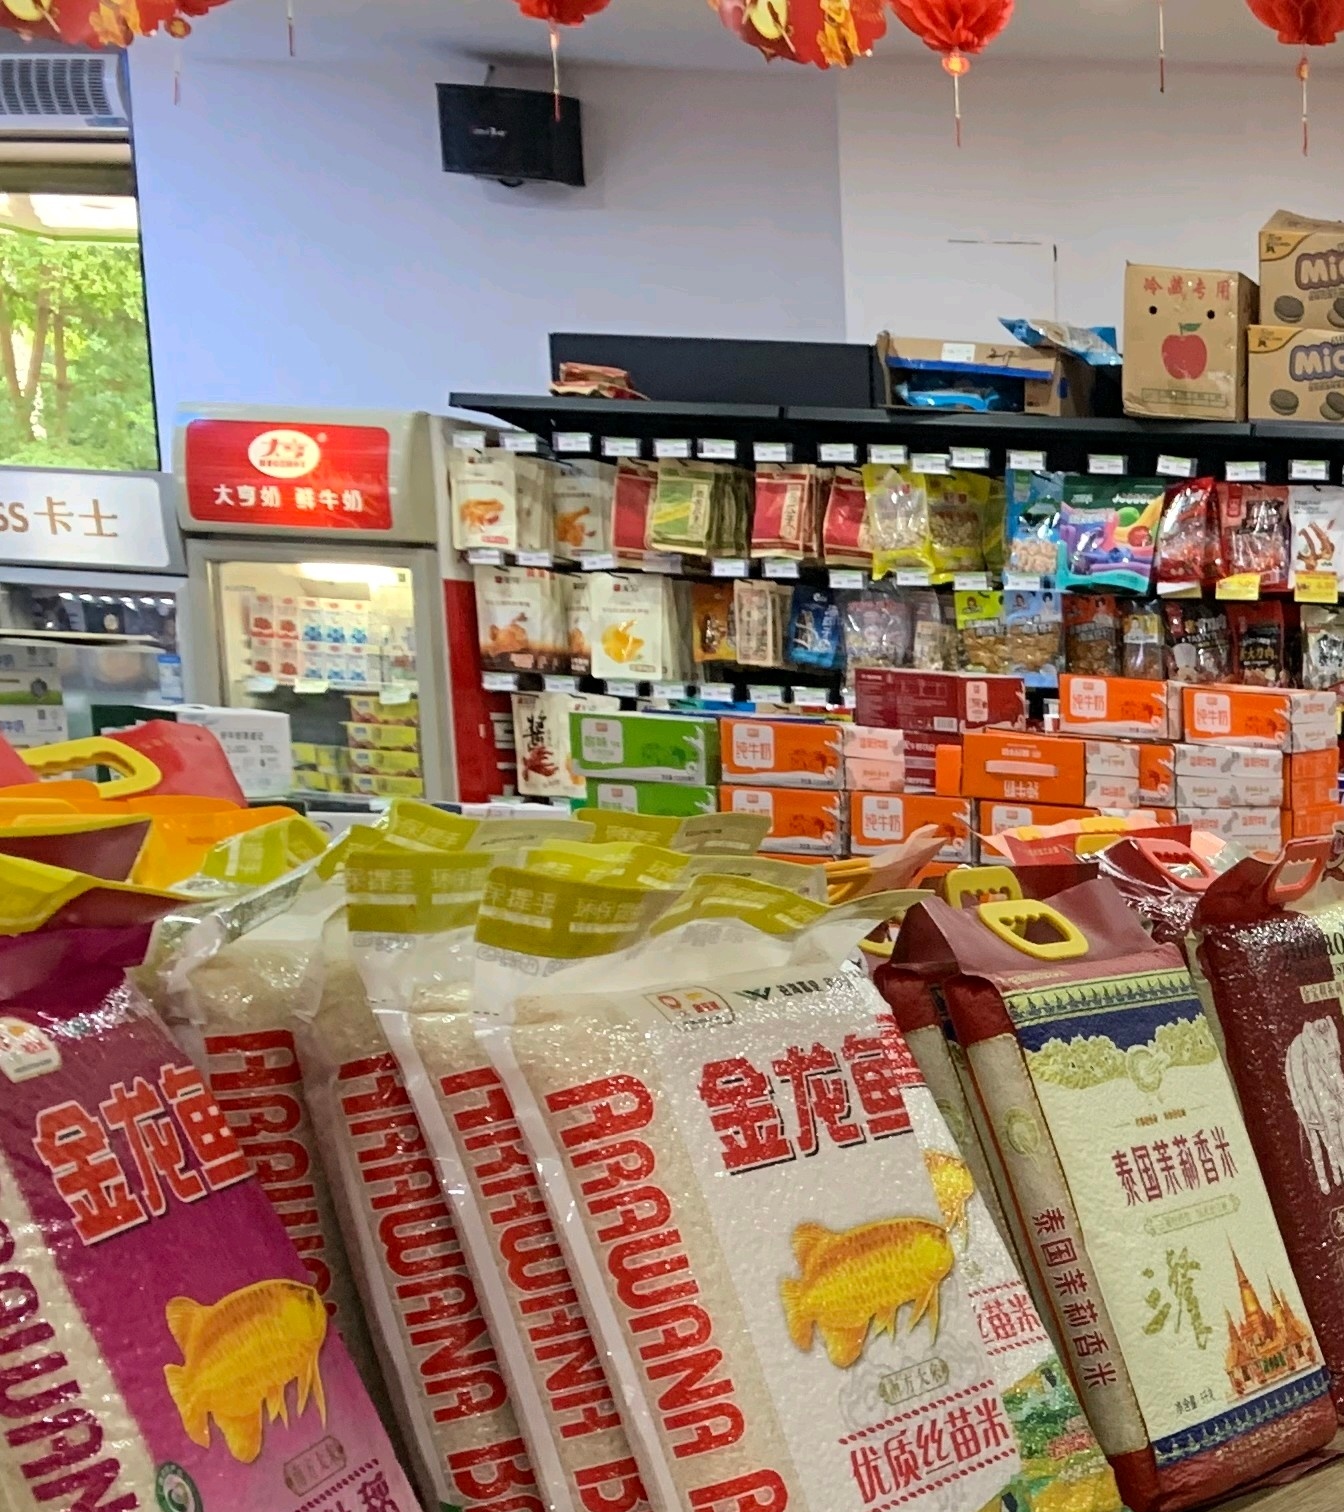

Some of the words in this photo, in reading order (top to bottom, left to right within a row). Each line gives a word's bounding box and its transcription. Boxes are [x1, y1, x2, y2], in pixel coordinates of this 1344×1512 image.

[33, 496, 118, 537] 卡士
[213, 484, 280, 508] 大亨奶
[294, 486, 364, 513] 鲜牛奶
[736, 742, 771, 760] 纯牛奶
[34, 1063, 257, 1246] 金龙鱼
[1111, 1125, 1239, 1207] 泰国茉莉香米
[544, 1073, 745, 1459] ARAWANA
[1031, 1206, 1119, 1394] 泰国茉莉香米
[849, 1397, 1010, 1505] 优质丝苗米
